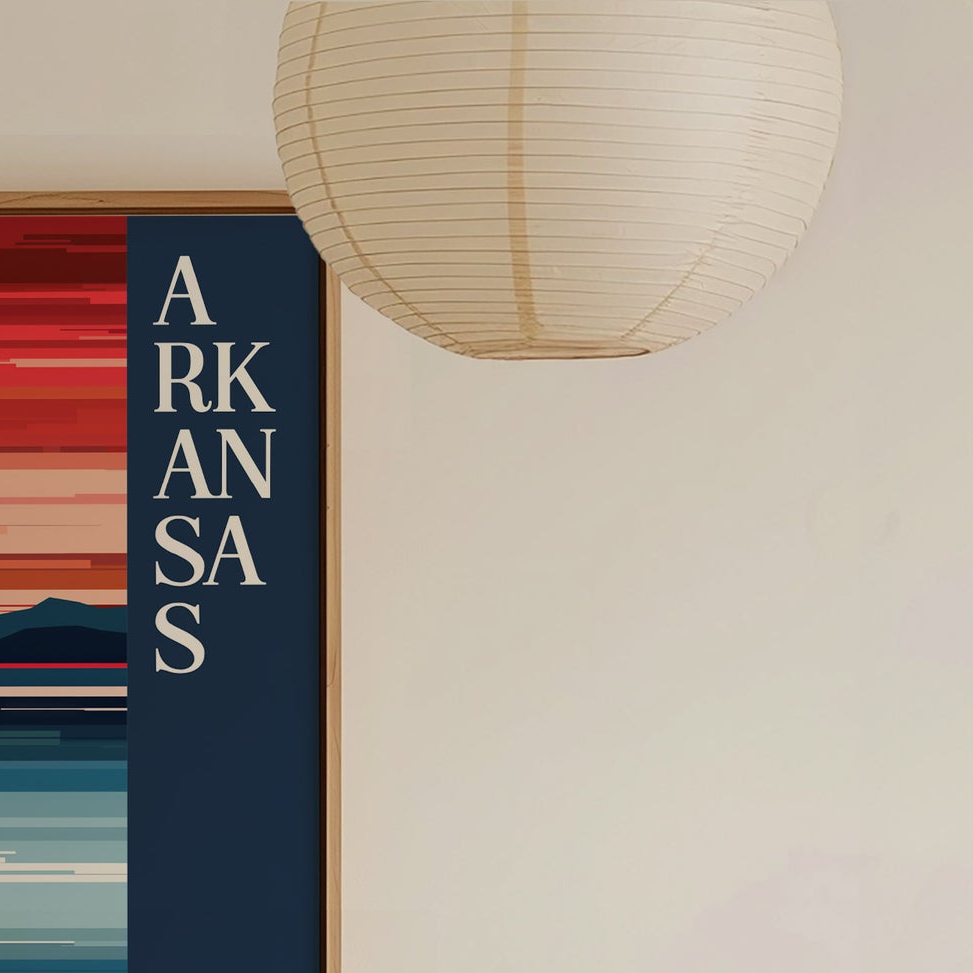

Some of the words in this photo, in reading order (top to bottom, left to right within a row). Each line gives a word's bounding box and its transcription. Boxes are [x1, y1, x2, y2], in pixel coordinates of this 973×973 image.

[153, 256, 217, 325] A
[154, 342, 276, 412] RK
[153, 429, 276, 499] AN
[155, 516, 266, 586] SA
[155, 603, 205, 673] S
